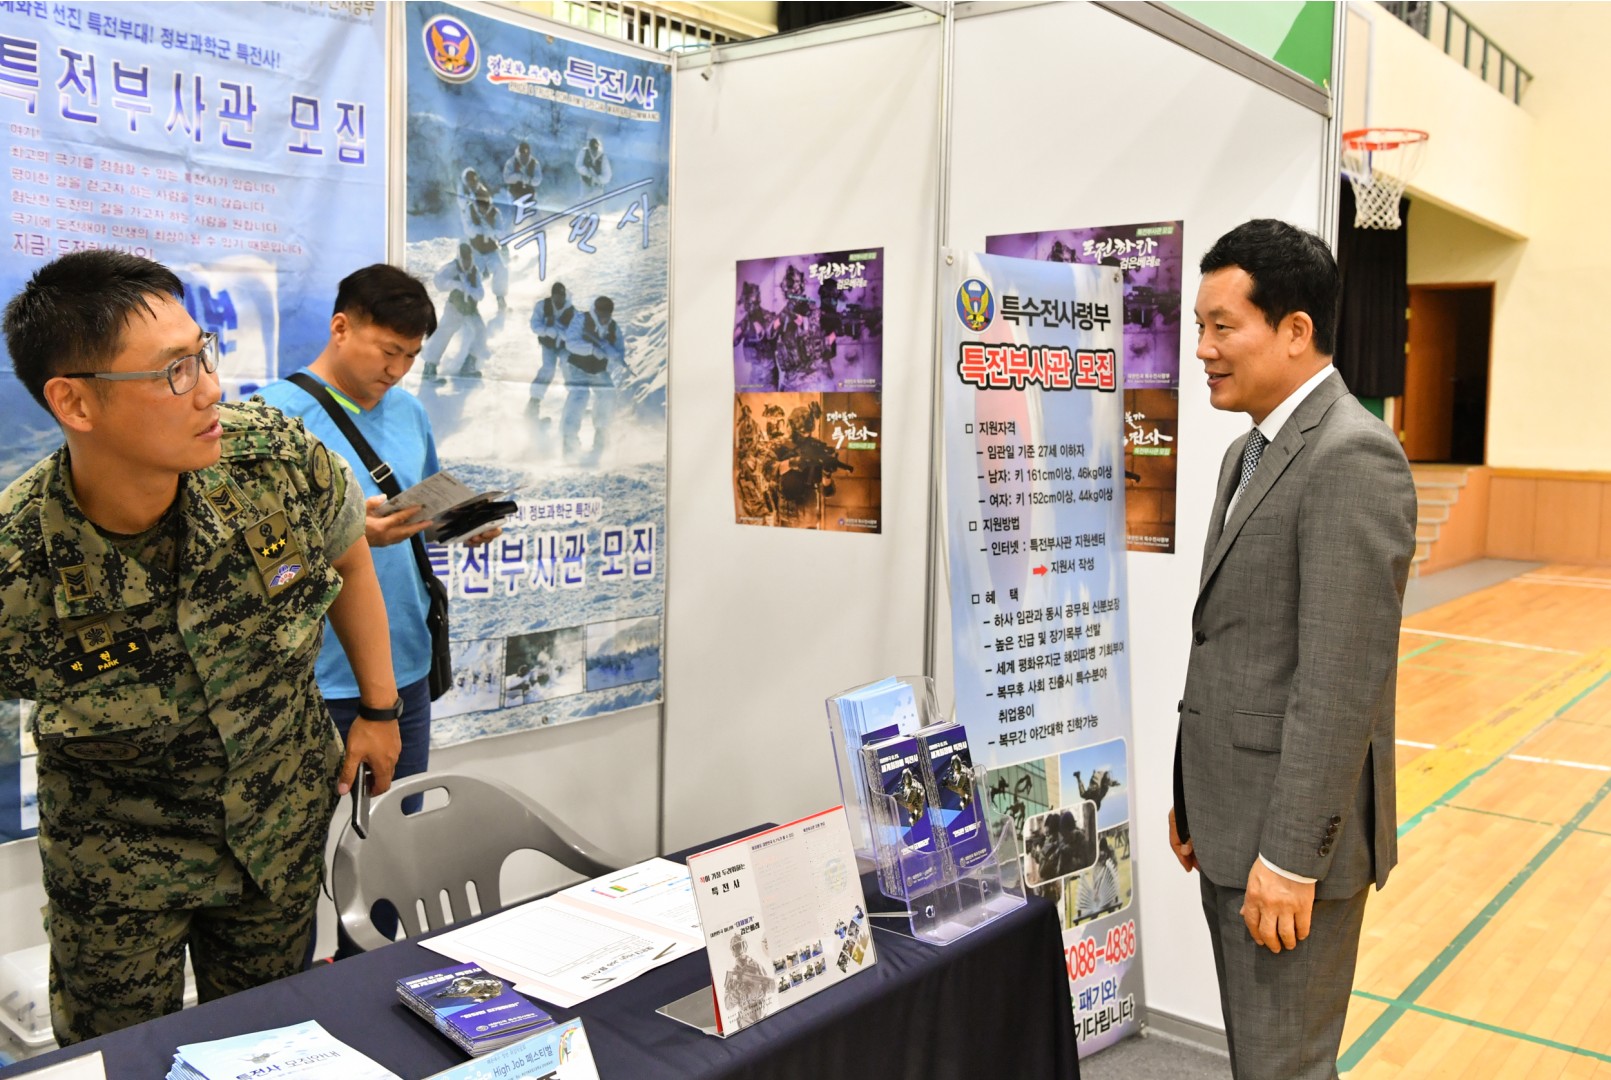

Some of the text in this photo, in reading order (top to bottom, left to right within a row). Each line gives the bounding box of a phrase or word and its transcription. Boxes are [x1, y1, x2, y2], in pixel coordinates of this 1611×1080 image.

[53, 3, 81, 30] 선진
[87, 12, 155, 43] 특전부대!
[161, 27, 231, 60] 정보과학군
[237, 43, 281, 68] 특전사!
[566, 59, 655, 107] 특전사
[0, 36, 366, 164] 특전부사관 모집
[12, 146, 49, 163] 최고의
[141, 167, 151, 177] 수
[14, 233, 51, 256] 지금!
[1000, 294, 1111, 331] 특수전사령부
[960, 343, 1115, 389] 특전부사관 모집
[979, 421, 1016, 436] 지원자격
[988, 444, 1085, 460] 임관일 기준 27세 이하자
[988, 470, 1011, 484] 남자:
[1014, 469, 1024, 483] 키
[1077, 465, 1112, 480] 46kg이상
[530, 503, 573, 521] 정보과학군
[576, 502, 601, 518] 특전사!
[989, 493, 1012, 508] 여자:
[1015, 493, 1025, 507] 키
[1078, 488, 1113, 503] 44kg이상
[983, 516, 1020, 532] 지원방법
[601, 527, 653, 577] 모집
[991, 532, 1106, 556] 인터넷 특전부사관 지원센터
[1050, 556, 1095, 574] 지원서 작성
[994, 597, 1120, 628] 하사 임관과 동시 공무원 신분보장
[994, 636, 1014, 652] 높은
[1017, 632, 1035, 649] 진급
[1038, 629, 1047, 645] 및
[1085, 622, 1101, 639] 선발
[98, 658, 120, 671] PARK
[996, 658, 1015, 676] 세계
[1018, 652, 1061, 673] 평화유지군
[1063, 645, 1096, 664] 해외파병
[997, 667, 1107, 700] 복무후 사회 진출시 특수분야
[998, 704, 1035, 725] 취업용이
[998, 713, 1099, 748] 복무간 야간대학 진학가능
[1078, 977, 1117, 1011] 패기와
[1074, 996, 1135, 1042] 기다립니다
[493, 1063, 511, 1079] High
[512, 1060, 525, 1072] Job
